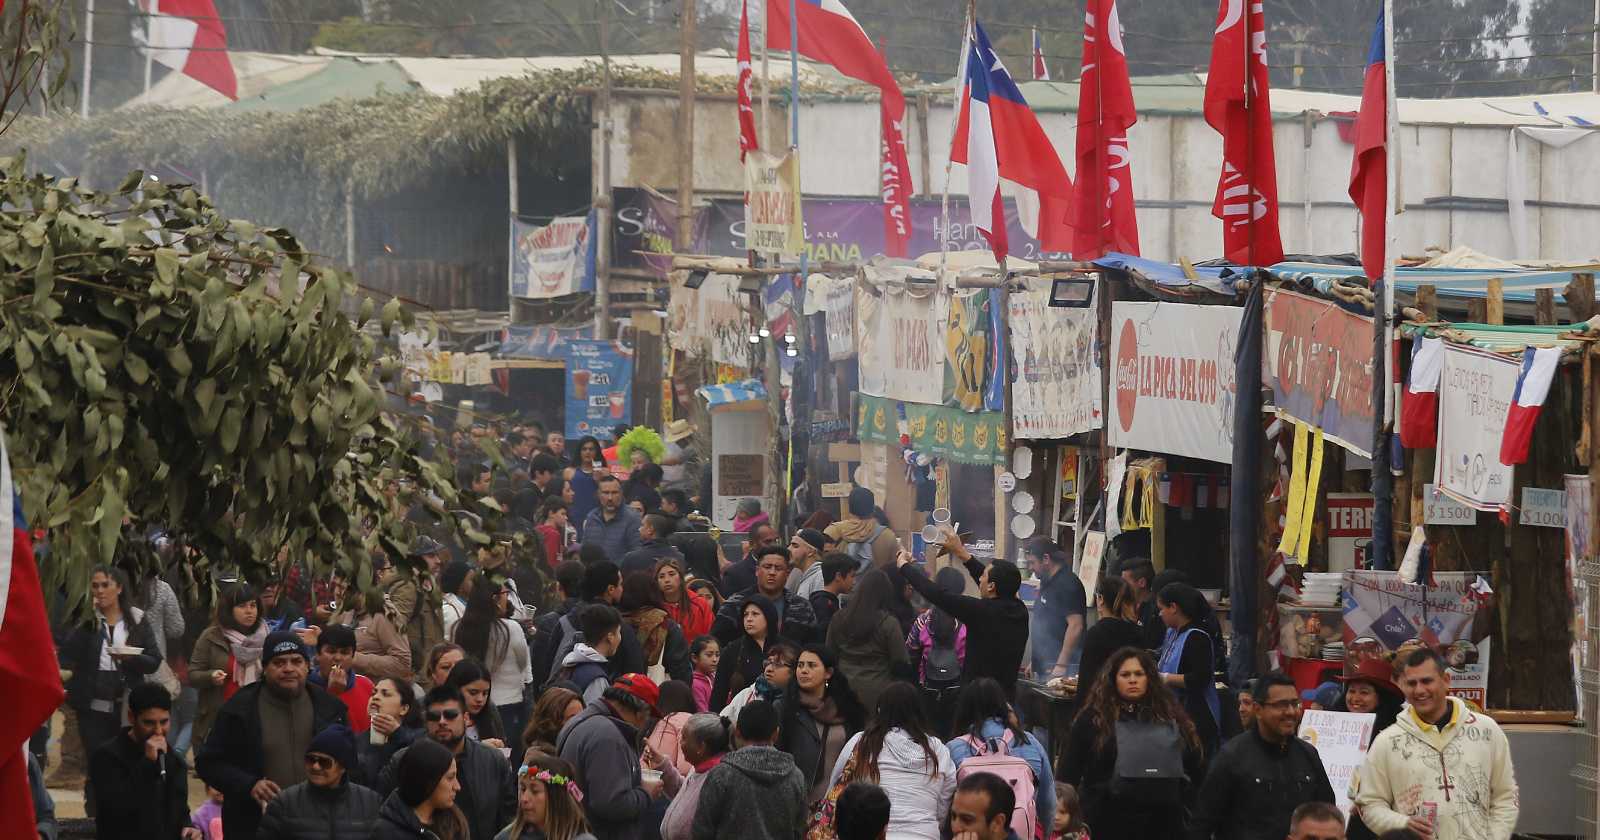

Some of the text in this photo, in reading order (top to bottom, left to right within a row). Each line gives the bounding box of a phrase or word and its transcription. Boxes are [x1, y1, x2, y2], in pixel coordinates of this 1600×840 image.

[1140, 356, 1152, 397] LA
[1153, 356, 1177, 399] PICA
[1180, 357, 1197, 401] DEL
[1439, 507, 1471, 519] 1500
